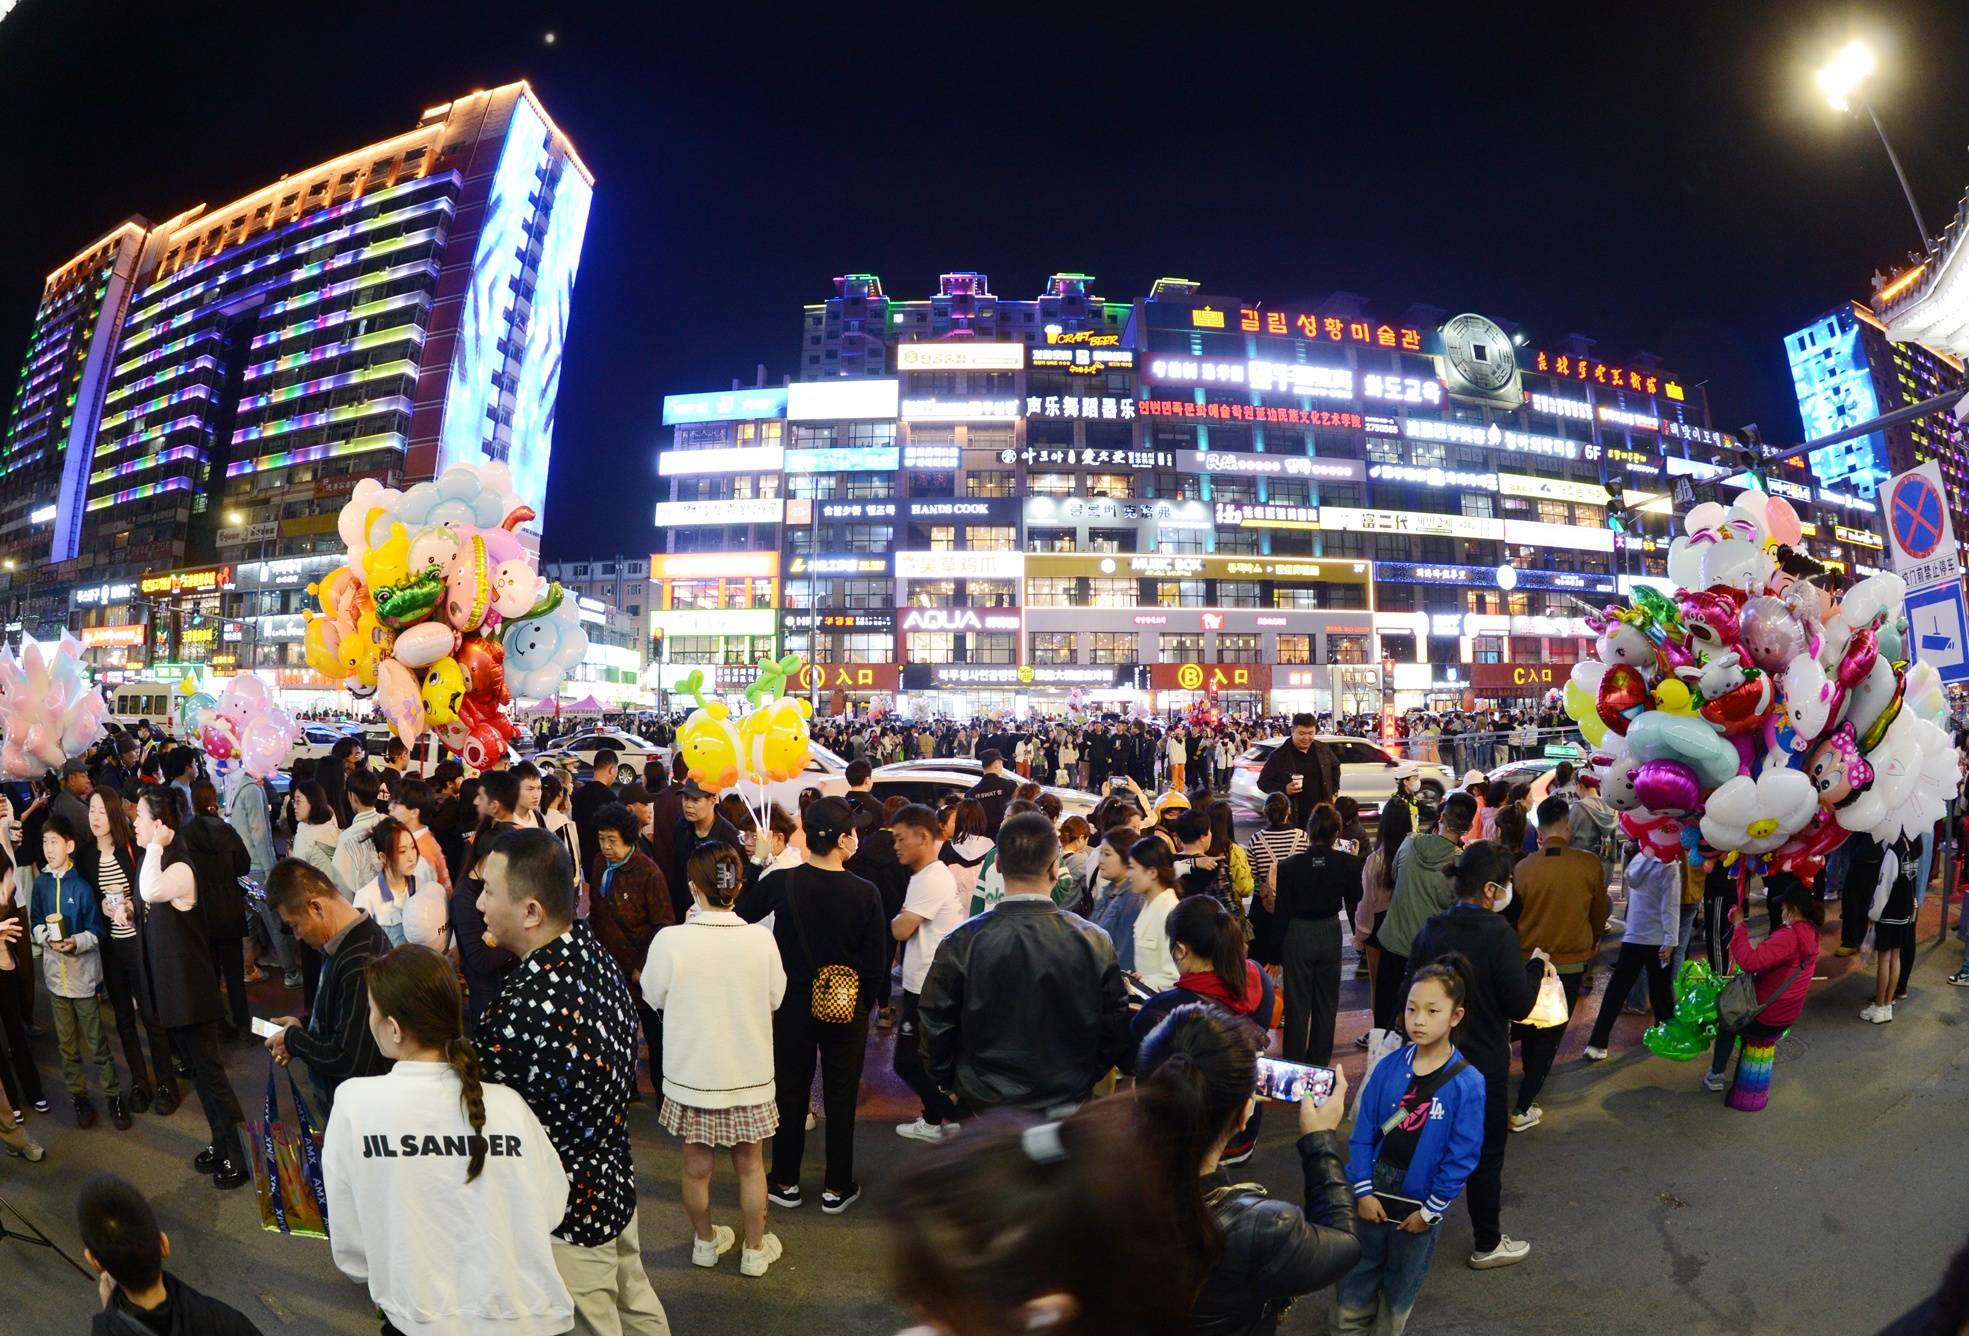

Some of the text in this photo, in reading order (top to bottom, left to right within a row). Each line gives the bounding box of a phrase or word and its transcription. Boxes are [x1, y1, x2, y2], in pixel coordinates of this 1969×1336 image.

[1057, 330, 1119, 346] CRAFT BEER
[1240, 308, 1421, 350] 길림성황미술관
[1255, 405, 1362, 429] 延边民族文化艺术学院
[1585, 445, 1602, 461] 6F
[911, 503, 989, 515] HANDS COOK
[1132, 558, 1202, 571] MUSIC BOX
[1901, 559, 1955, 586] 校门前禁止停车
[903, 610, 982, 629] AQUA
[835, 667, 873, 686] 入口
[1183, 668, 1248, 685] B 入口
[1514, 667, 1552, 685] C 入口
[1429, 1096, 1445, 1120] LA
[304, 1137, 317, 1165] AMX
[362, 1134, 398, 1159] JIL
[312, 1177, 327, 1205] AMX
